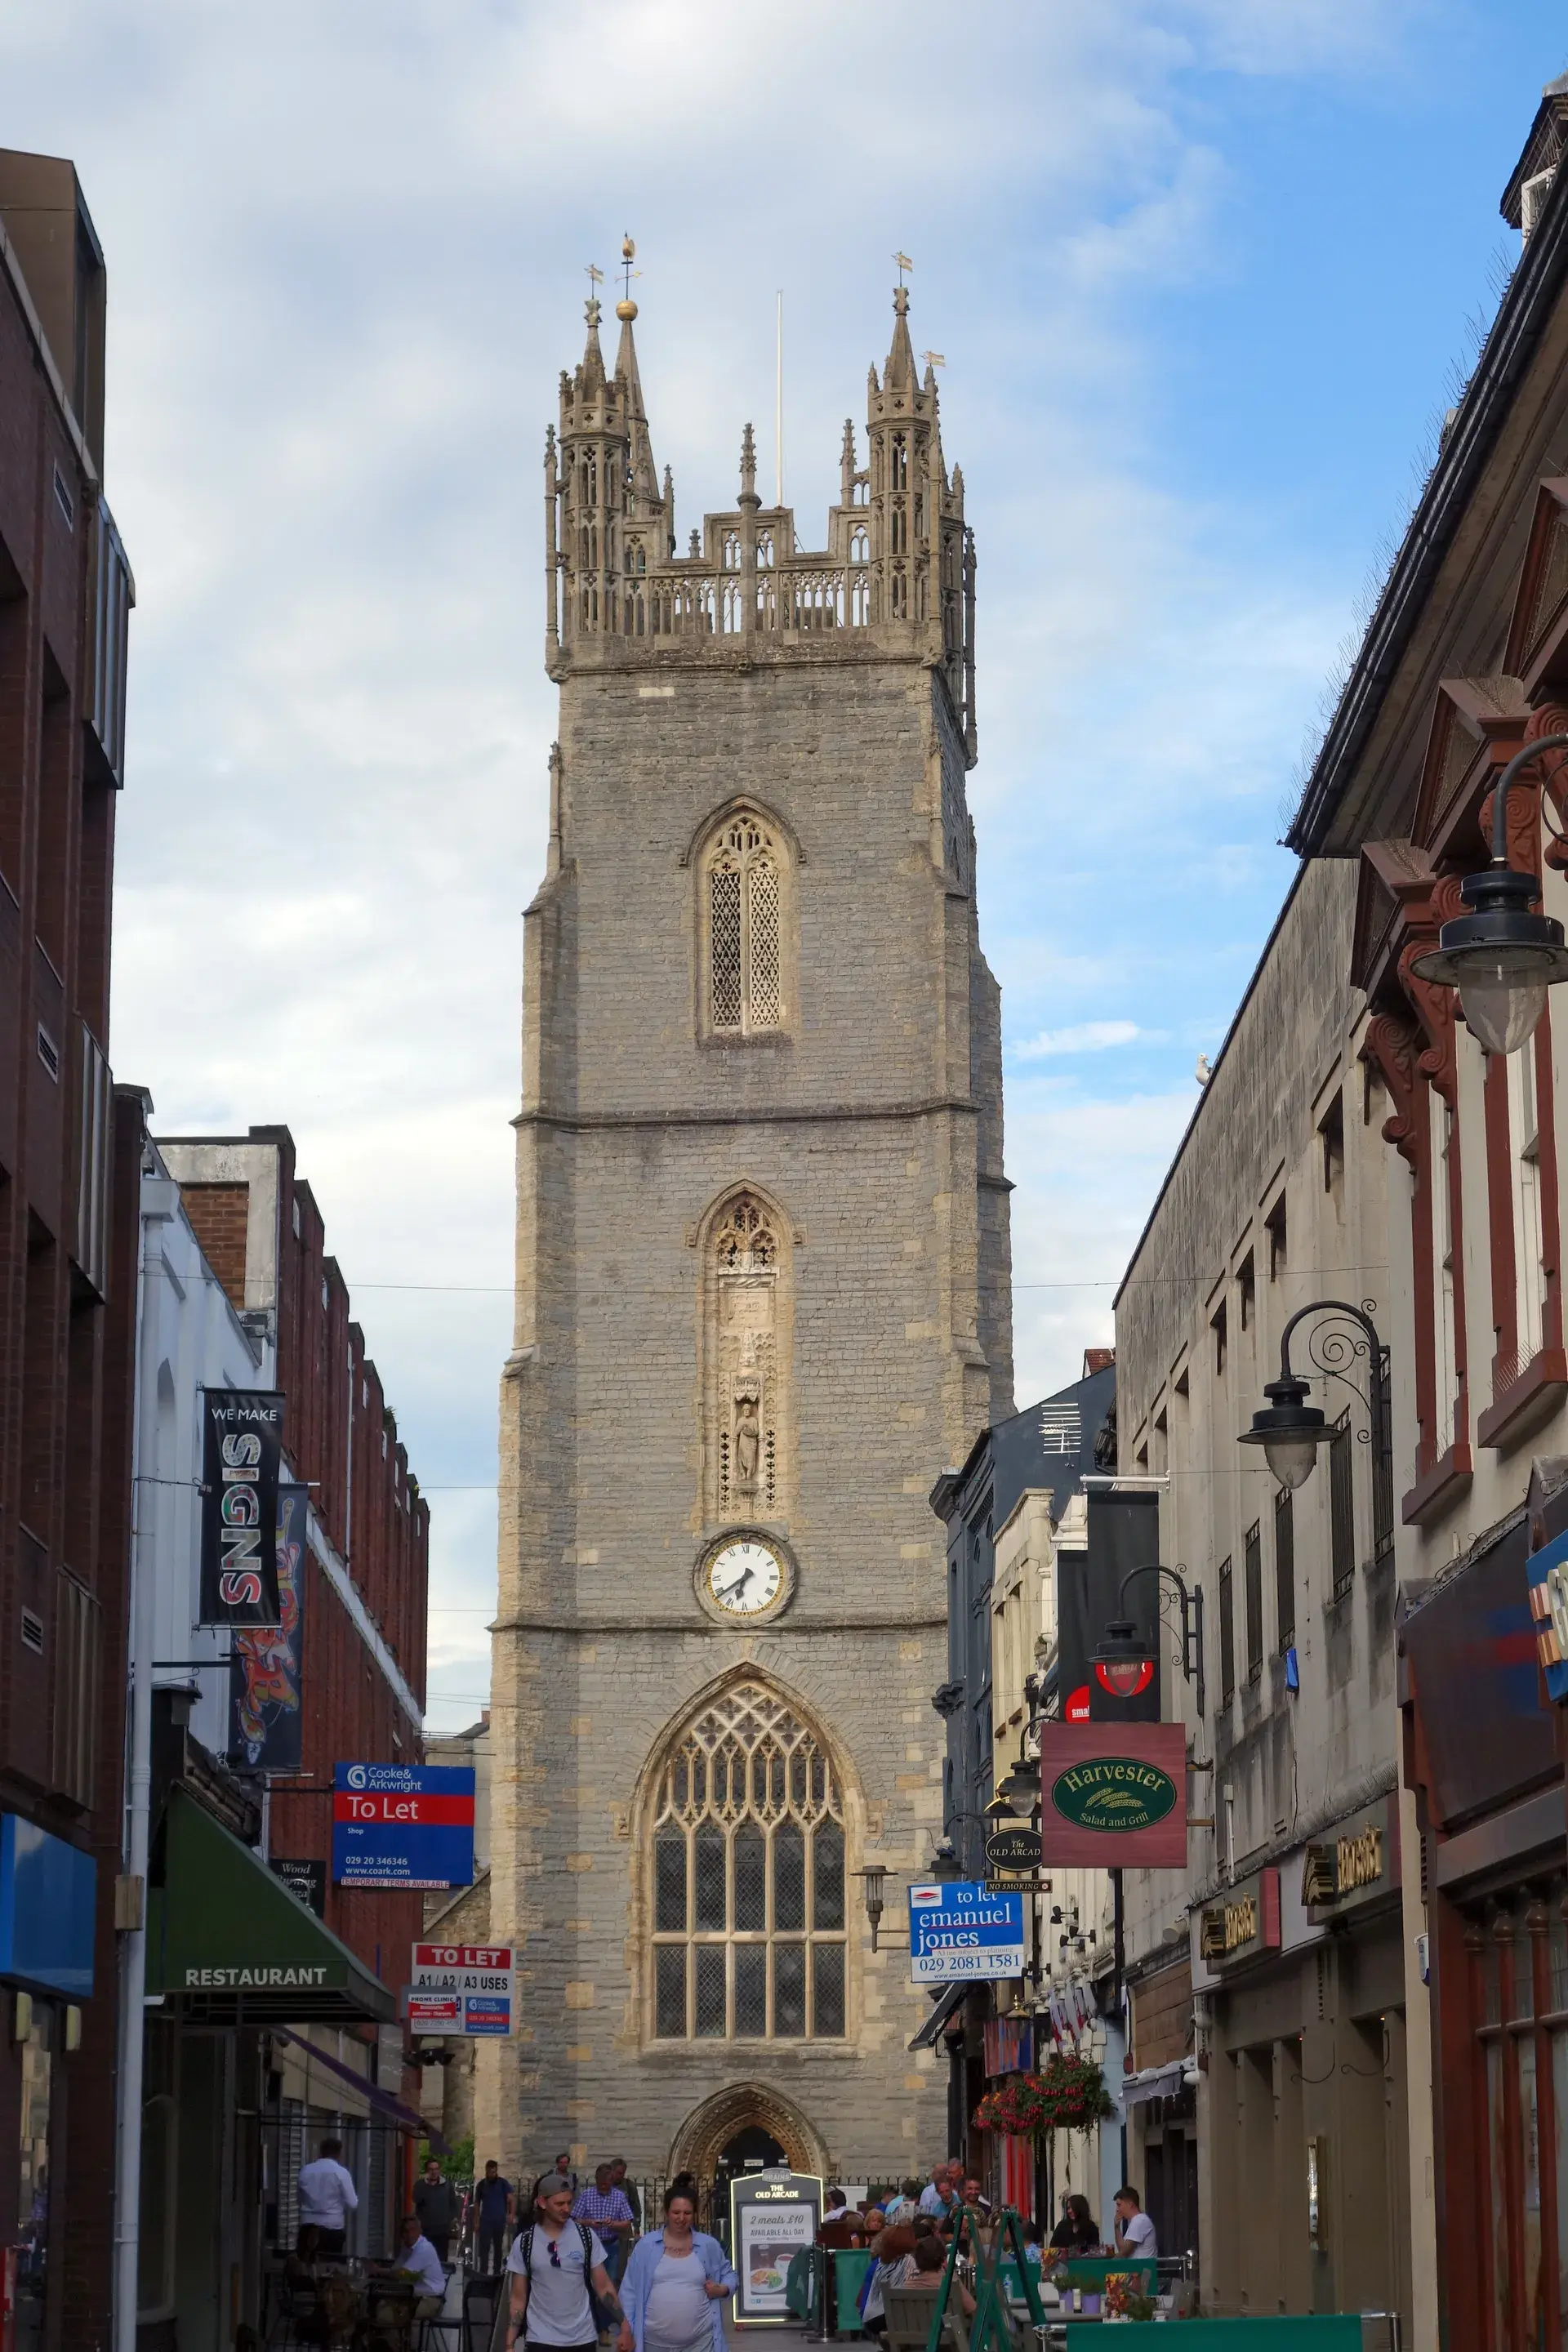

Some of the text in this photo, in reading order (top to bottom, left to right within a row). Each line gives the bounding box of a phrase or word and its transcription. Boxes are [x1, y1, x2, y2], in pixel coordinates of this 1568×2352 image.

[212, 1408, 277, 1421] WE MAKE
[219, 1433, 261, 1605] SIGNS
[368, 1766, 412, 1780] Cooke&
[1062, 1765, 1165, 1793] Harvester
[368, 1779, 421, 1793] Arkwright
[347, 1797, 418, 1820] To Let
[1080, 1811, 1149, 1827] Salad and Grill
[347, 1828, 363, 1836] Shop
[1011, 1840, 1025, 1848] The
[1010, 1848, 1040, 1856] ARCAD
[345, 1856, 361, 1864] 029
[376, 1857, 408, 1865] 346346
[281, 1863, 311, 1874] Wood
[345, 1867, 410, 1876] www.coark.com
[341, 1878, 449, 1889] TEMPORARY TERMS AVAILABLE
[956, 1891, 973, 1904] to
[920, 1902, 1011, 1927] emanuel
[918, 1929, 979, 1956] jones
[431, 1949, 501, 1967] TO LET
[959, 1949, 978, 1957] subject
[987, 1947, 1013, 1956] planning
[920, 1954, 1020, 1972] 029 2081 1581
[185, 1967, 327, 1986] RESTAURANT
[934, 1971, 1007, 1979] www.emanuel-jones.co.uk
[418, 1974, 431, 1986] A1
[442, 1975, 455, 1987] A2
[464, 1976, 477, 1989] A3
[480, 1977, 508, 1990] USES
[771, 2190, 799, 2198] ARCADE
[751, 2214, 804, 2225] 2 meals £10
